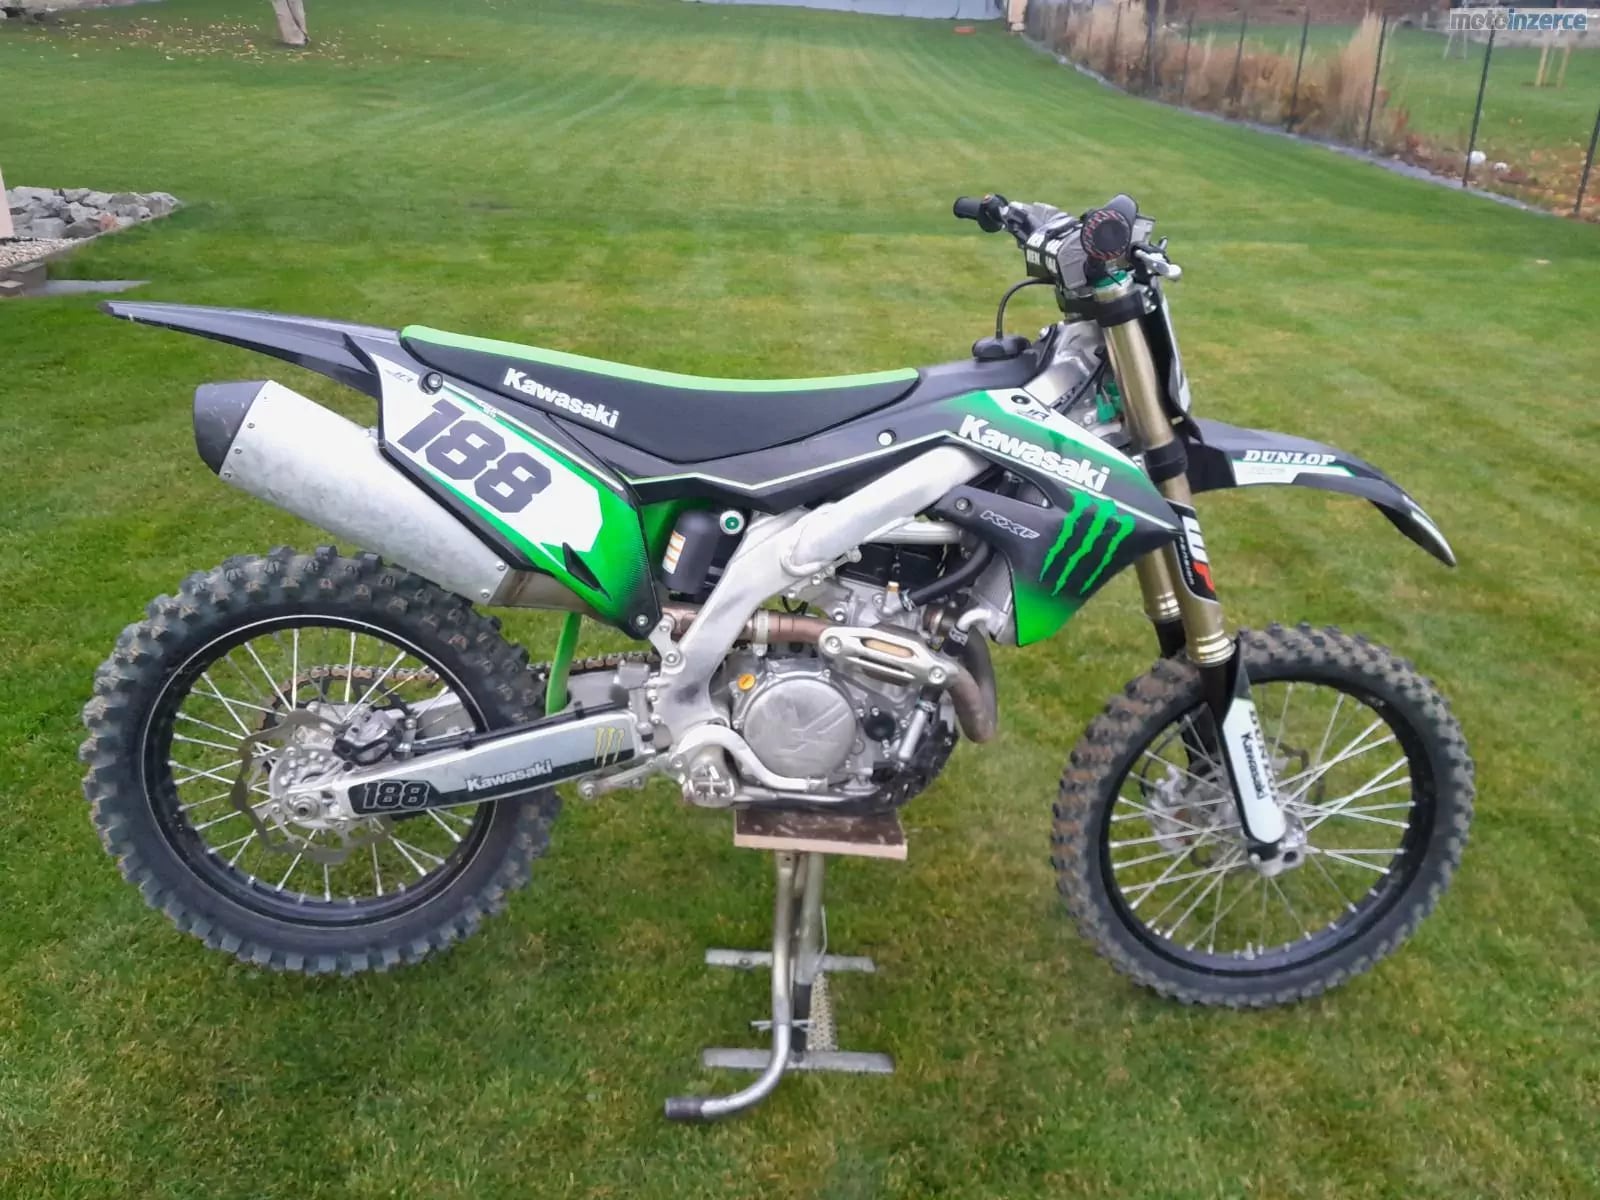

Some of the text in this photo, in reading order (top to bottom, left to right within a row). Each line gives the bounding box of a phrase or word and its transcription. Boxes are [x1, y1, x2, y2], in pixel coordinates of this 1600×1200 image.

[503, 367, 620, 429] Kawasaki
[398, 398, 553, 514] 188
[958, 414, 1110, 492] Kawasaki
[1243, 449, 1337, 466] DUNLOP
[980, 510, 1041, 539] KXF
[466, 759, 553, 793] Kawasaki
[1241, 731, 1269, 800] Kawasaki
[363, 780, 430, 809] 188
